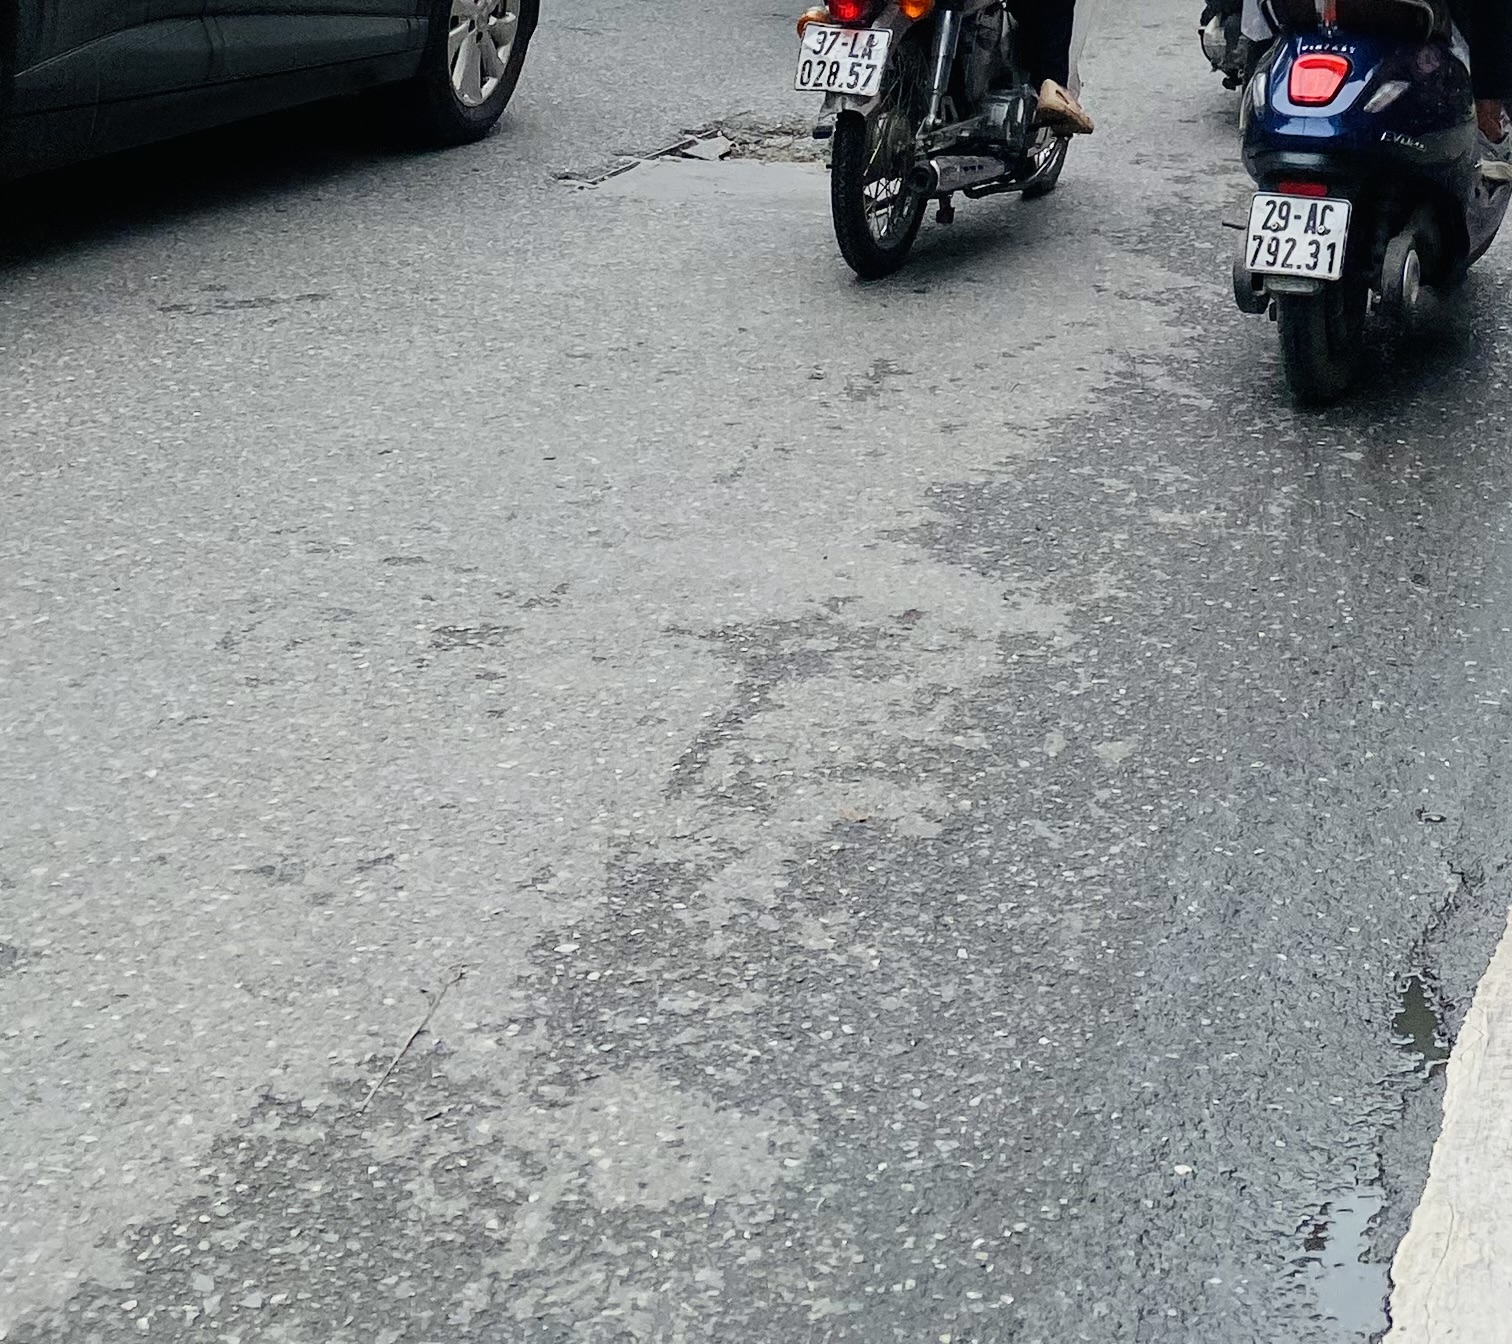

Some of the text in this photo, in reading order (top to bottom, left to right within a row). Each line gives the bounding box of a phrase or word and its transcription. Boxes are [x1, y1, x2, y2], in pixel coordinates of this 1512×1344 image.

[812, 30, 877, 61] 37-LA
[800, 59, 878, 92] 028.57
[1262, 199, 1335, 236] 29-AC
[1249, 235, 1337, 274] 792.31
